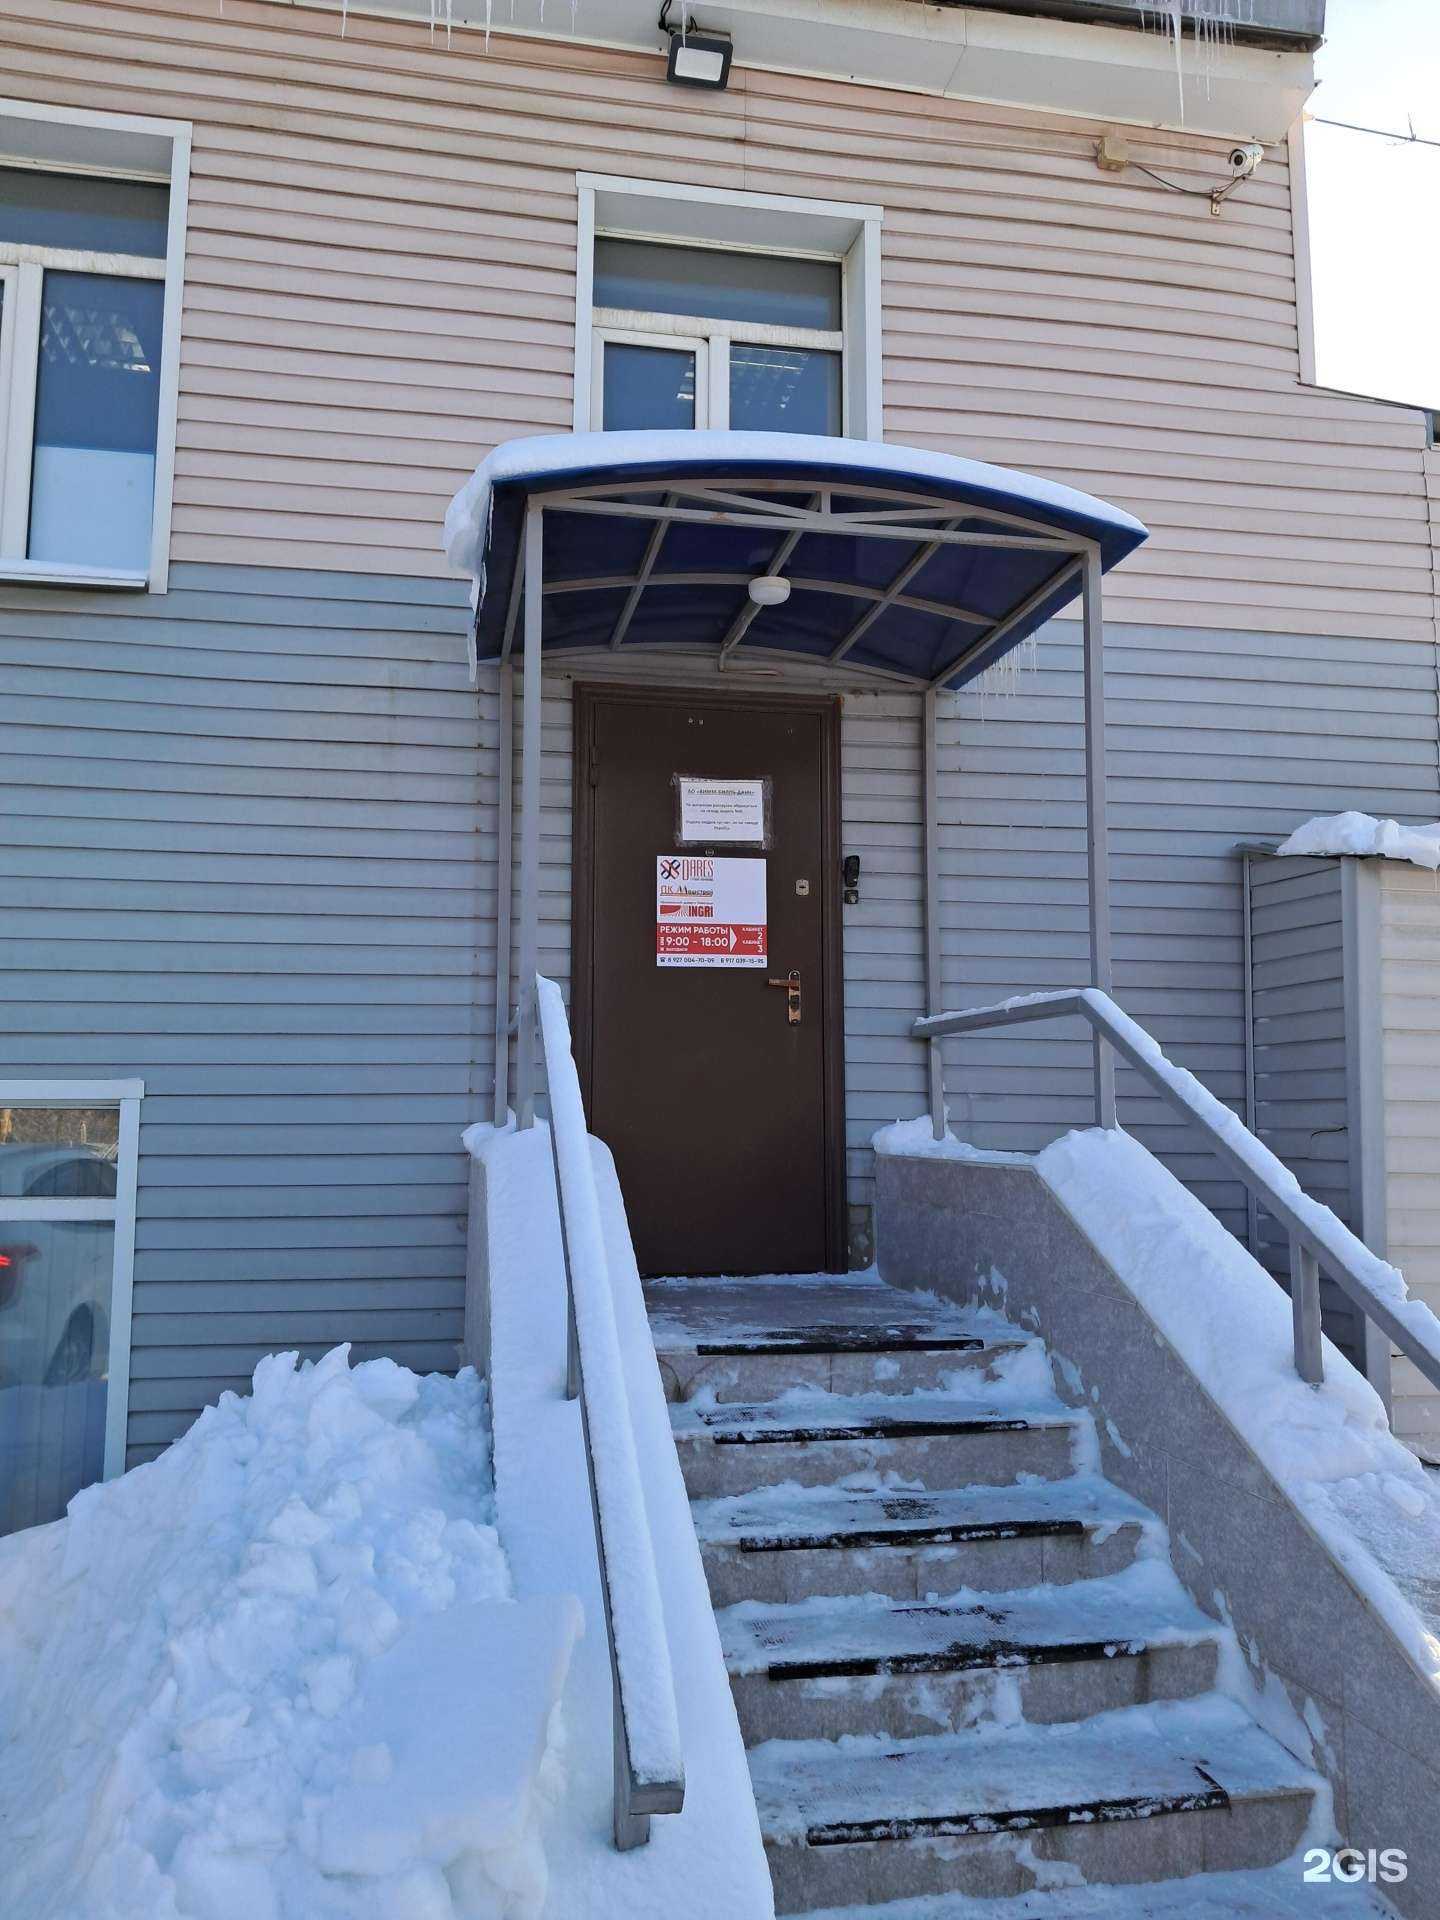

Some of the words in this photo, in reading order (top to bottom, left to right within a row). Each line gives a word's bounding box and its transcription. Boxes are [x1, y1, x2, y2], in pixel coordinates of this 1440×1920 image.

[688, 905, 714, 918] INGRI
[660, 926, 692, 934] РЕЖИМ
[693, 926, 729, 935] РАБОТЫ
[757, 931, 763, 940] 2
[666, 936, 690, 946] 9:00
[700, 937, 729, 947] 18:00
[757, 944, 763, 953] 3
